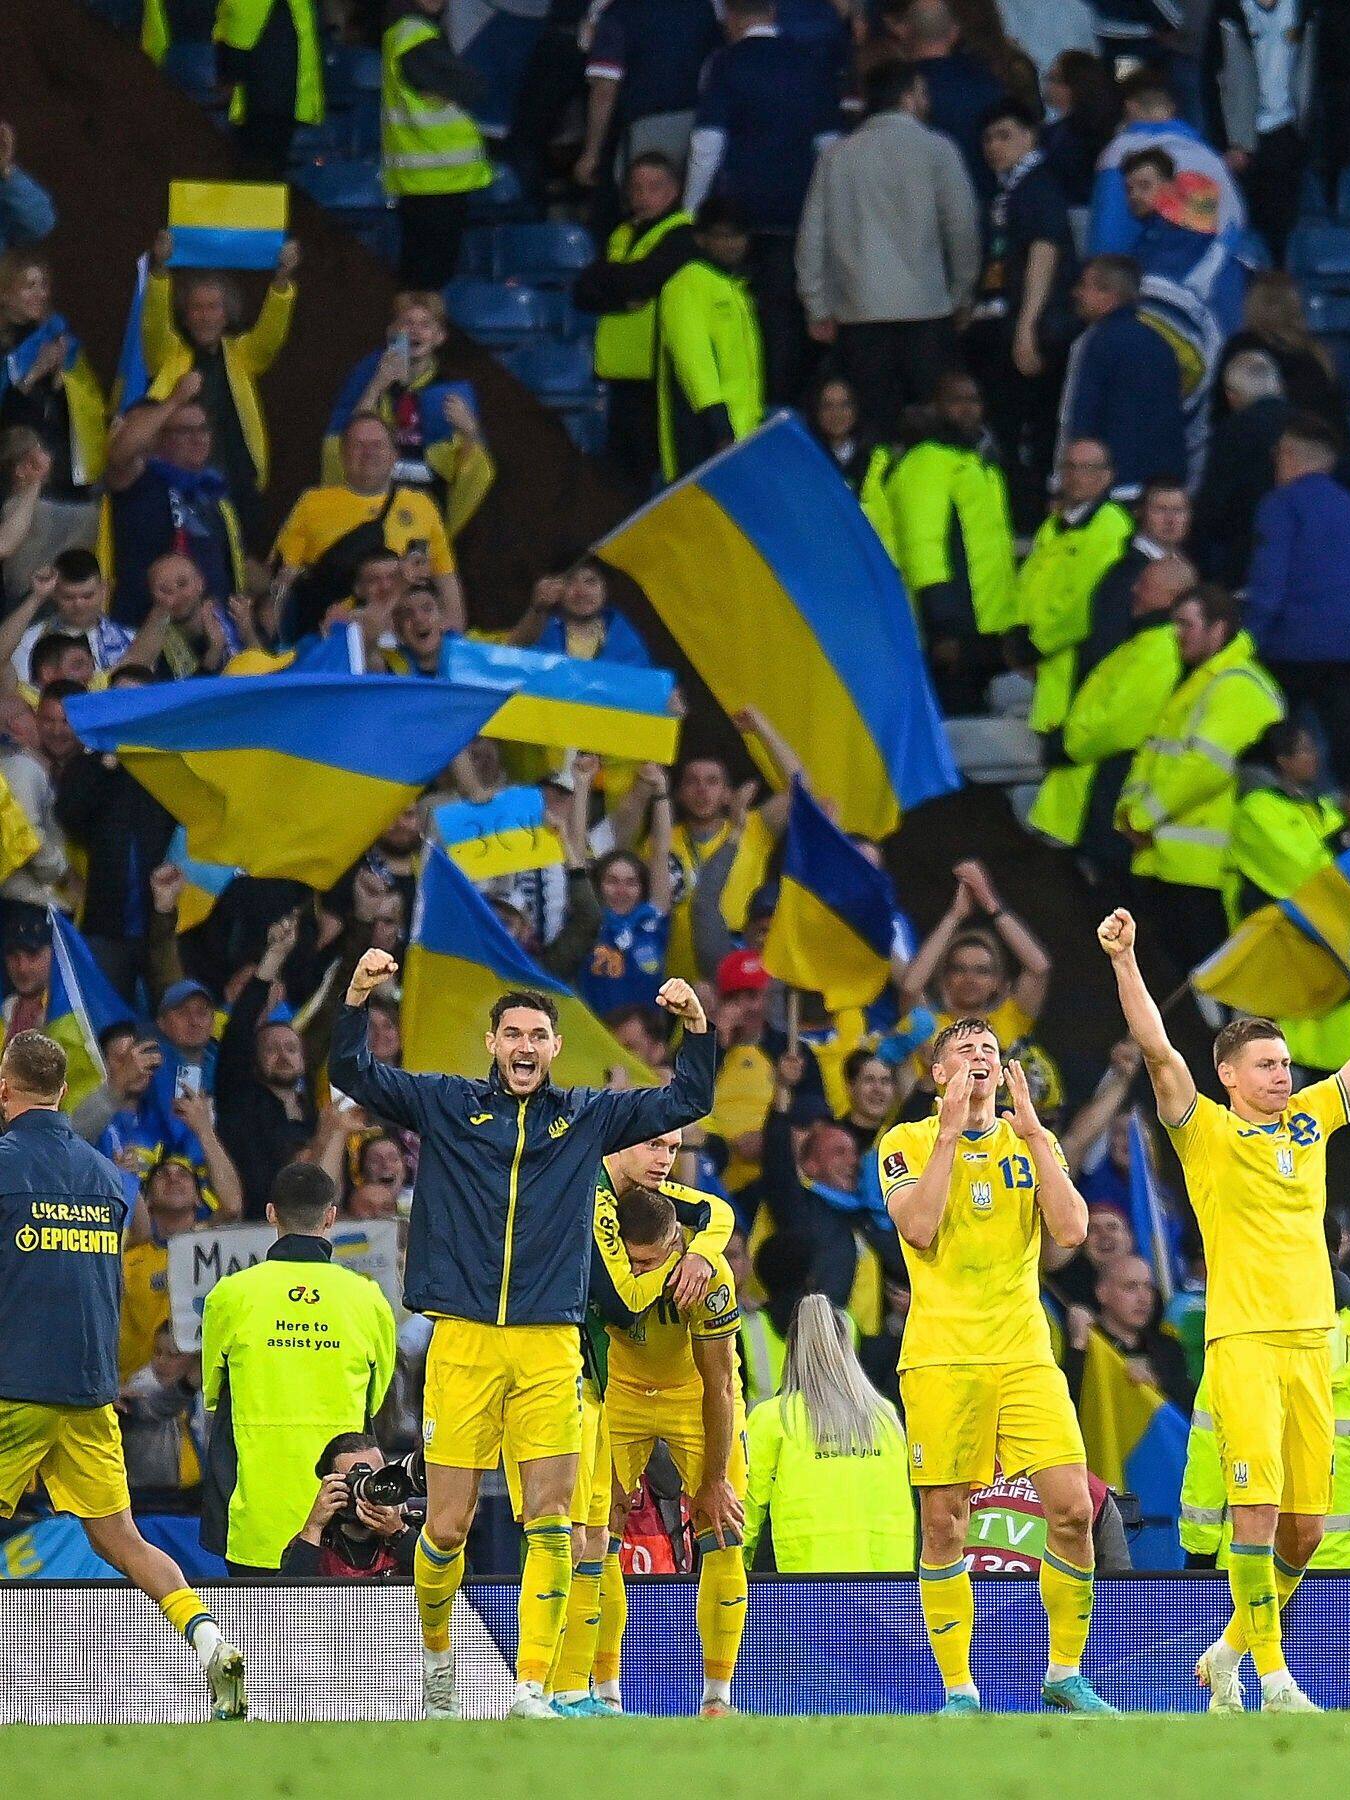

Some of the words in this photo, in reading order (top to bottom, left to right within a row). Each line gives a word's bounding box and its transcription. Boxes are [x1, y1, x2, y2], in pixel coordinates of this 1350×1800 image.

[998, 1153, 1034, 1189] 13
[31, 1201, 111, 1224] UKRAINE
[40, 1227, 119, 1255] EPICENTR
[288, 1286, 320, 1305] G4S
[276, 1320, 310, 1332] Here
[314, 1321, 329, 1332] to
[267, 1337, 311, 1348] assist
[314, 1340, 341, 1351] you
[814, 1447, 857, 1459] asst
[970, 1485, 1042, 1505] QUALIFIE
[977, 1512, 1035, 1546] TV
